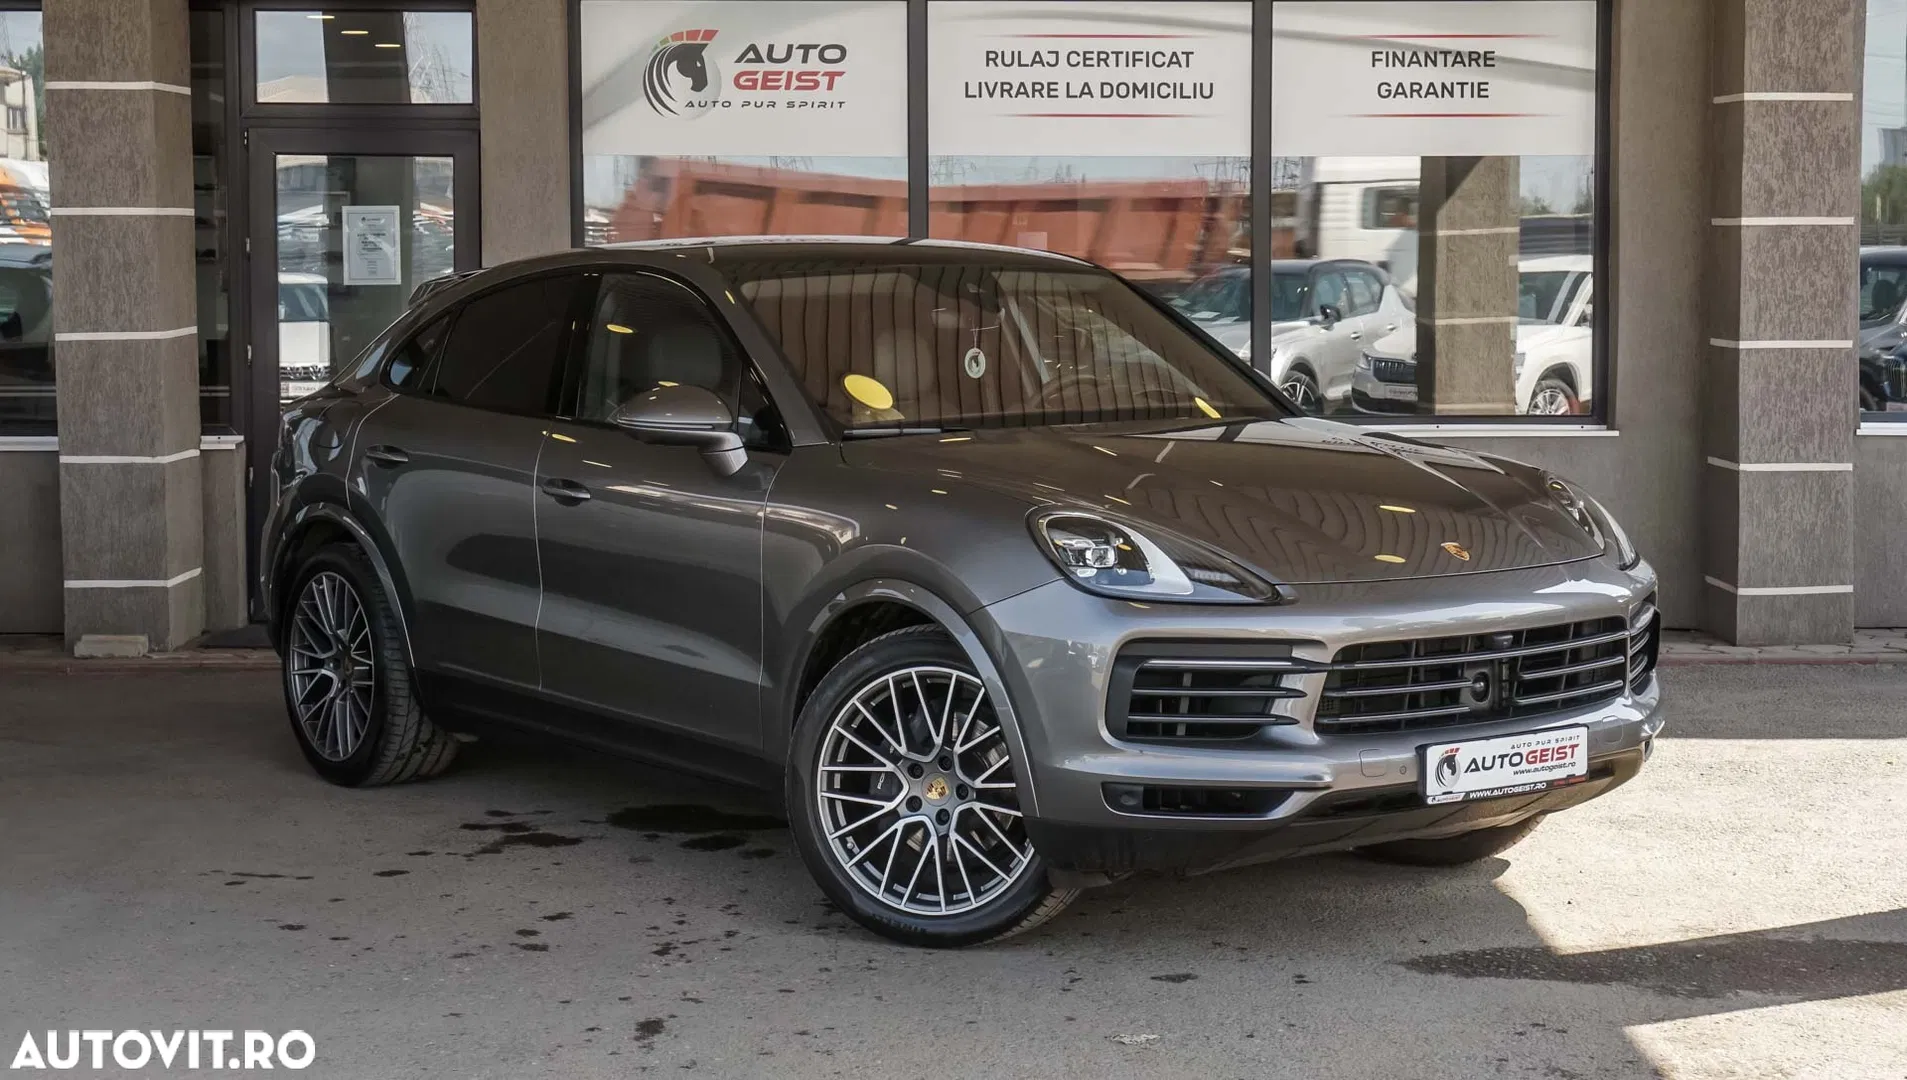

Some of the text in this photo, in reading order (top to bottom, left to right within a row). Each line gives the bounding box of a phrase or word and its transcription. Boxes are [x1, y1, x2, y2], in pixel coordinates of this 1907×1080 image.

[733, 43, 847, 64] AUTO
[985, 50, 1194, 68] RULAJ CERTIFICAT
[1371, 50, 1496, 68] FINANTARE
[732, 70, 847, 91] GEIST
[964, 81, 1214, 99] LIVRARE LA DOMICILIU
[1377, 81, 1490, 99] GARANTIE
[684, 100, 846, 109] AUTO PUR SPIRIT
[1510, 741, 1533, 750] AUTO
[1555, 734, 1580, 744] SPIRIT
[1513, 761, 1577, 776] www.autogeist.ro
[1469, 782, 1547, 799] WWW.AUTOGEIST.RO
